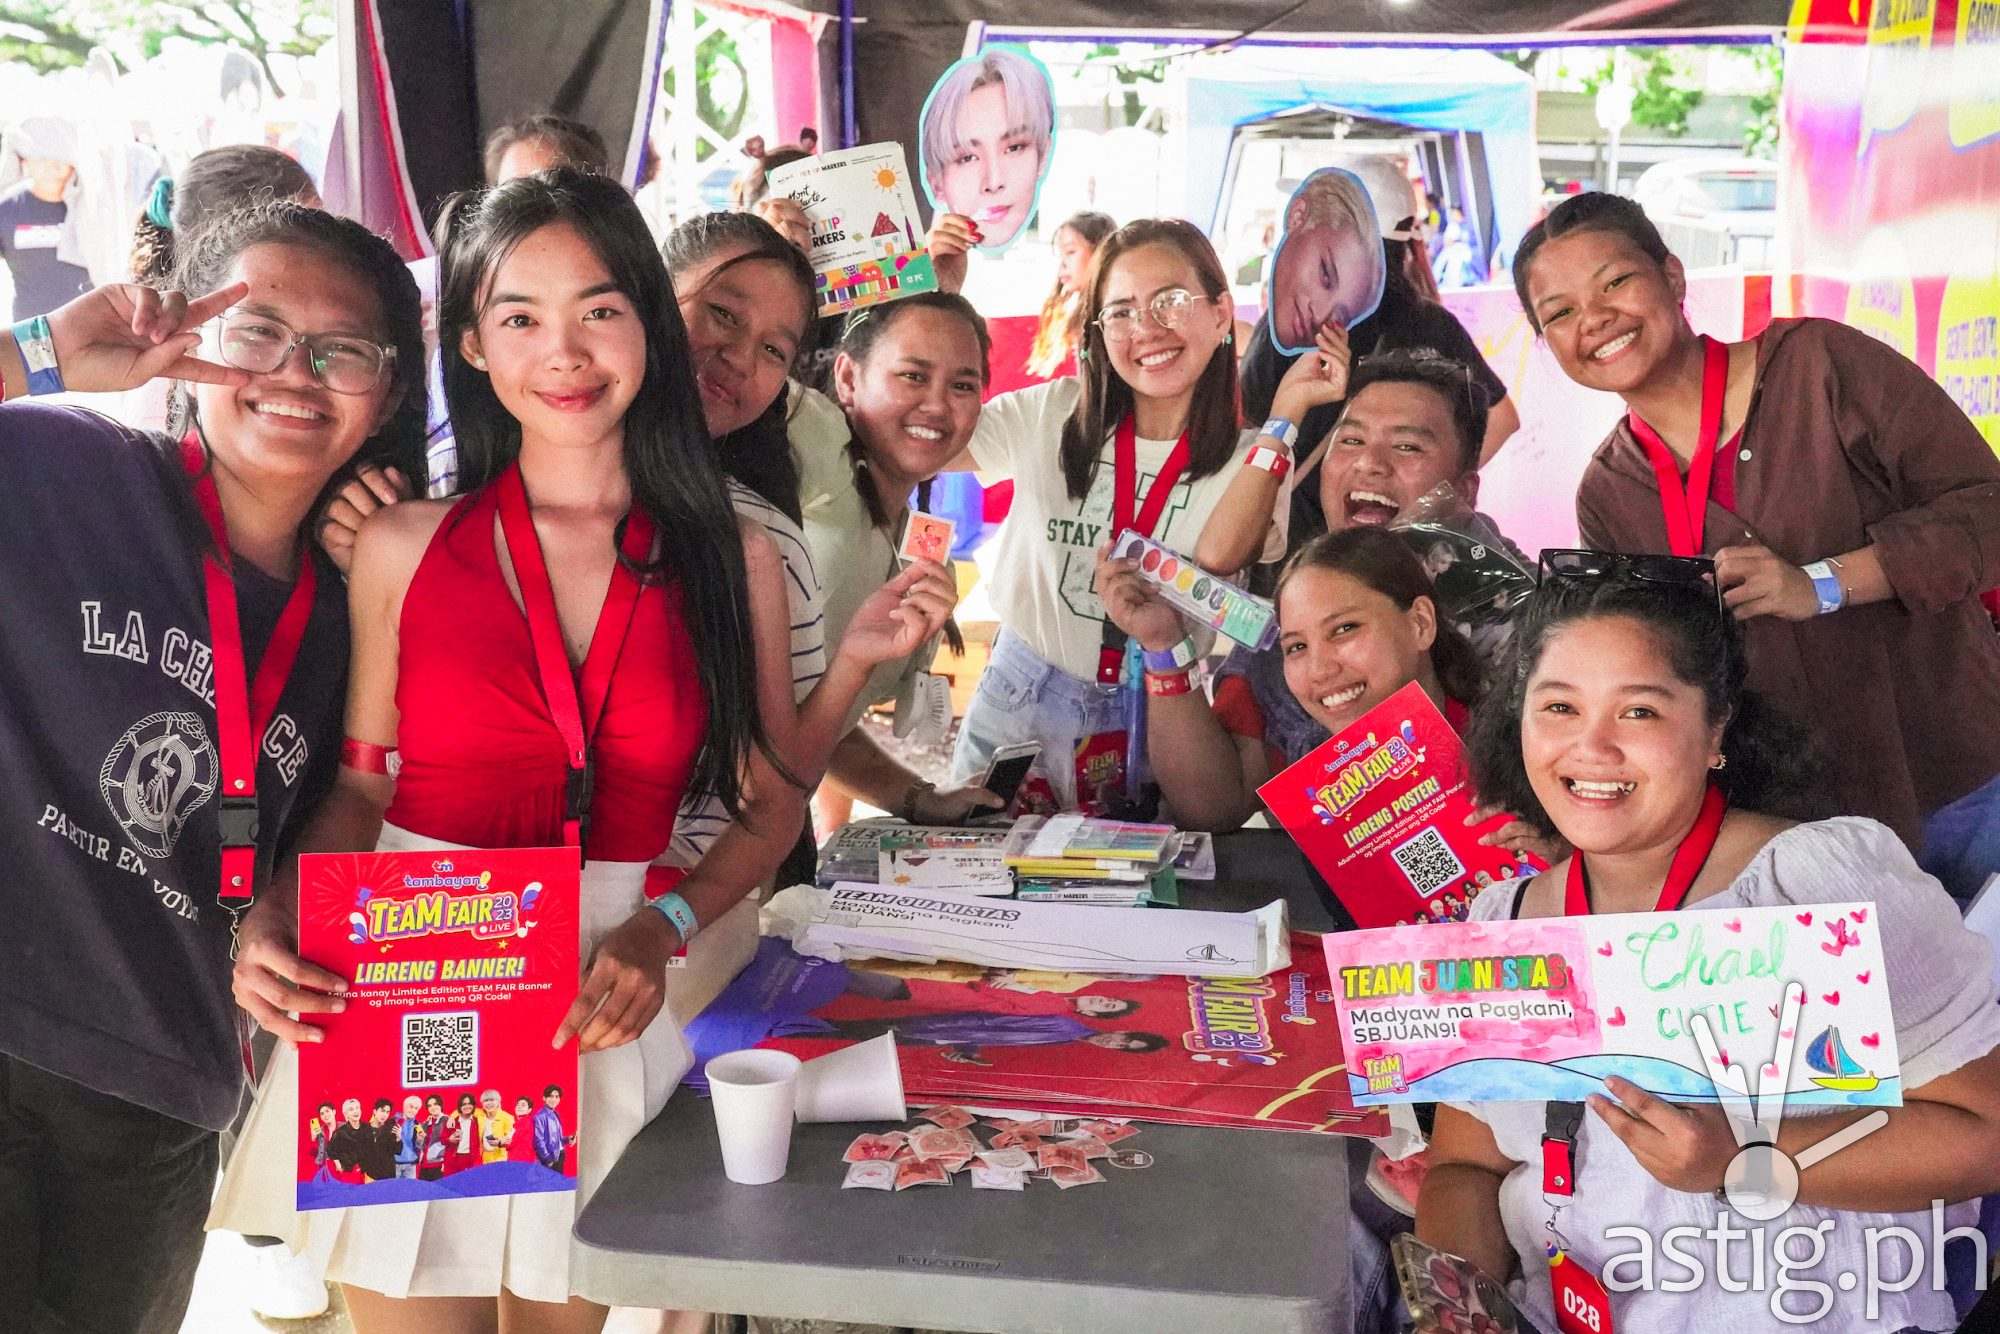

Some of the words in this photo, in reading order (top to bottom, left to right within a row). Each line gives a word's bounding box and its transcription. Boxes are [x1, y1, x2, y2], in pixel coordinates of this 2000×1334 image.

[820, 216, 841, 234] TIP
[812, 230, 846, 249] RKERS
[1046, 518, 1101, 548] STAY
[81, 601, 150, 664] LA
[1388, 740, 1401, 753] 20
[1319, 765, 1369, 813] TEAM
[1363, 748, 1397, 783] FAIR
[1343, 807, 1393, 849] LIBRENG
[1391, 775, 1441, 817] POSTER!
[1415, 803, 1433, 816] TEAM
[37, 804, 111, 863] PARTIR
[116, 846, 148, 876] EN
[494, 896, 512, 908] 20
[831, 900, 907, 915] Madyaw
[911, 911, 934, 919] na
[834, 889, 898, 906] TEAM
[898, 896, 1022, 922] JUANISTAS
[371, 896, 444, 935] TEAM
[447, 898, 494, 926] FAIR
[495, 909, 512, 920] 23
[489, 923, 510, 932] LIVE
[1626, 921, 1788, 991] Chael
[355, 960, 435, 984] LIBRENG
[441, 957, 525, 980] BANNER!
[1340, 962, 1413, 998] TEAM
[1419, 954, 1568, 993] JUANISTAS
[360, 989, 390, 1000] kanay
[392, 987, 429, 997] Limited
[431, 985, 465, 994] Edition
[466, 984, 493, 992] TEAM
[496, 983, 516, 991] FAIR
[518, 982, 553, 991] Banner
[369, 999, 382, 1008] og
[384, 997, 415, 1006] imong
[448, 996, 466, 1004] ang
[468, 994, 483, 1002] QR
[484, 993, 511, 1001] Code!
[1203, 997, 1260, 1034] FAIR
[1351, 1006, 1440, 1027] Madyaw
[1448, 1007, 1473, 1019] na
[1480, 1000, 1573, 1020] Pagkani,
[1210, 1033, 1235, 1048] 23
[1239, 1033, 1264, 1049] 20
[1354, 1023, 1457, 1044] SBJUAN9!
[1363, 1054, 1400, 1077] TEAM
[1369, 1075, 1393, 1093] FAIR
[1563, 1286, 1601, 1333] 028
